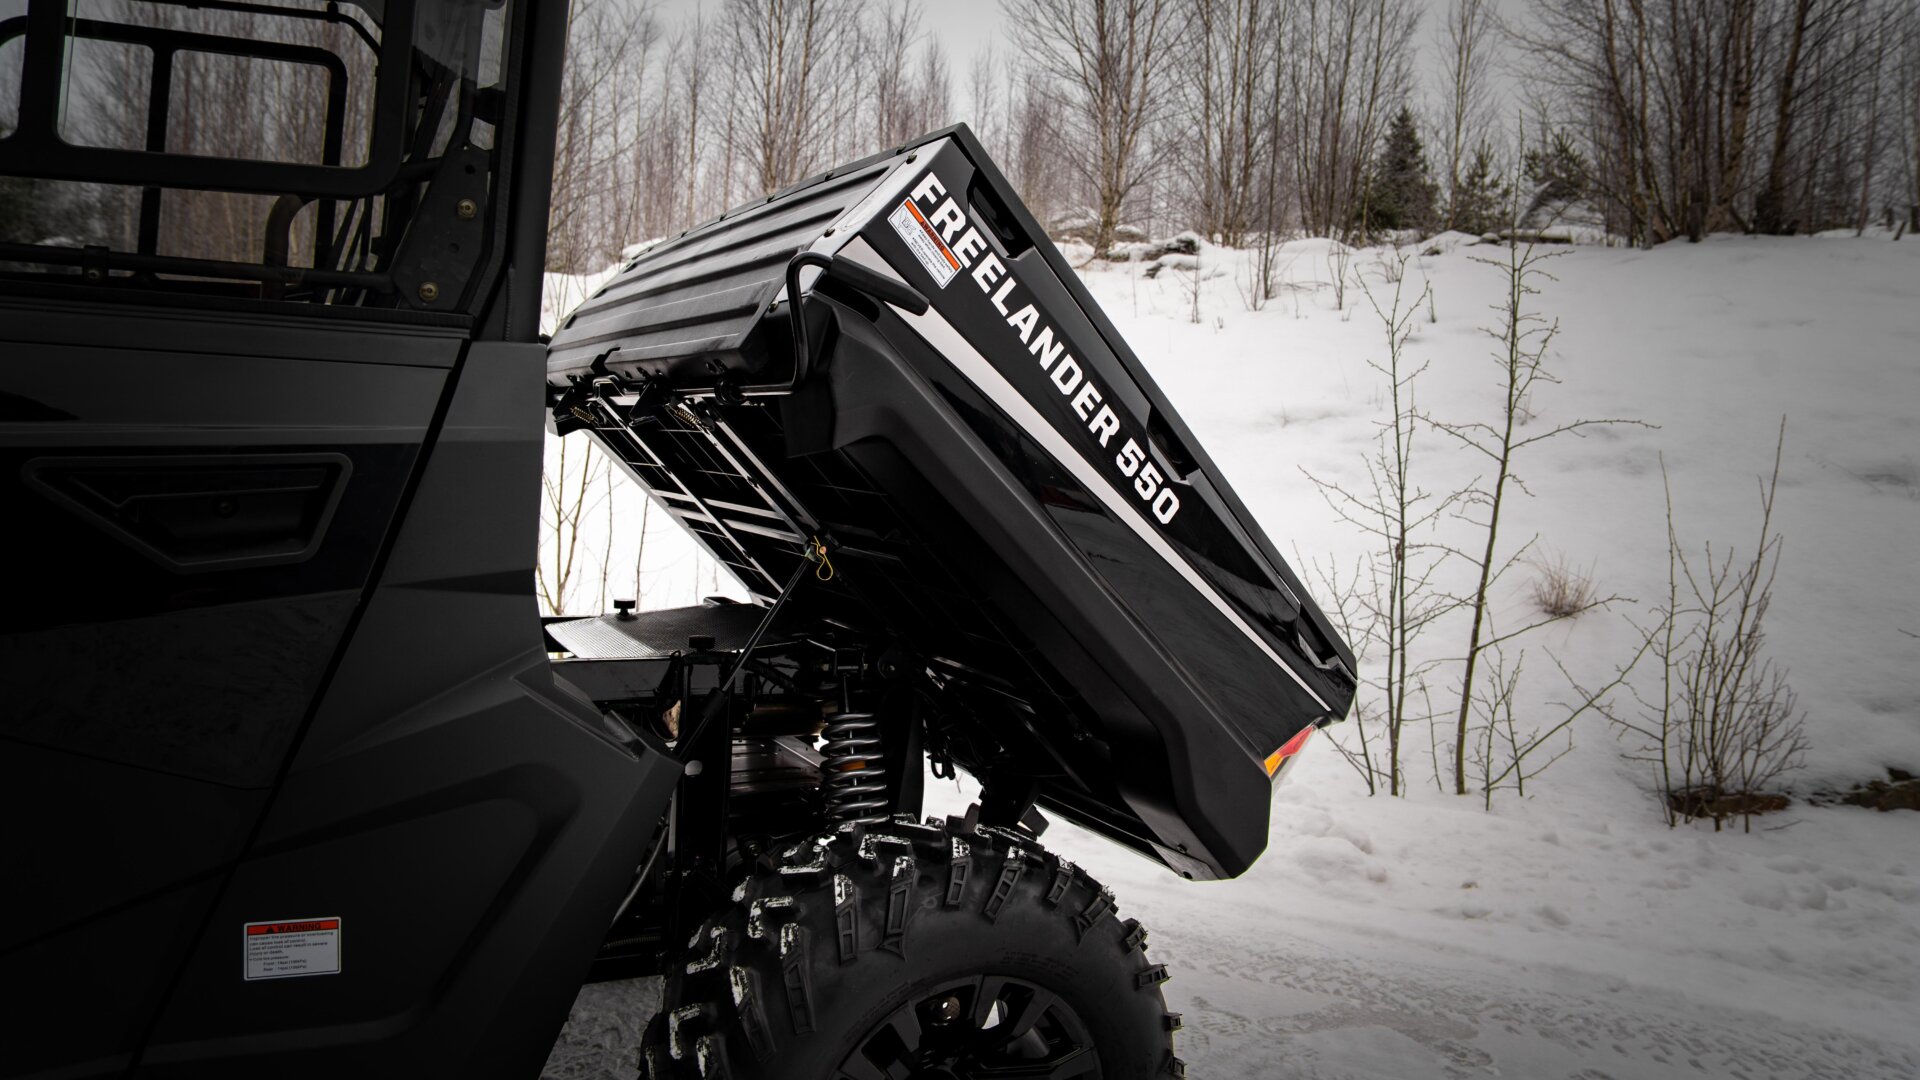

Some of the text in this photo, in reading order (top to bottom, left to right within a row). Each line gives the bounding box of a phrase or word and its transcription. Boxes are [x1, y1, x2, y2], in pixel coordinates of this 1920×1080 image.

[922, 224, 945, 251] WARNING
[910, 171, 1180, 524] FREELANDER 550
[277, 922, 322, 933] WARNING
